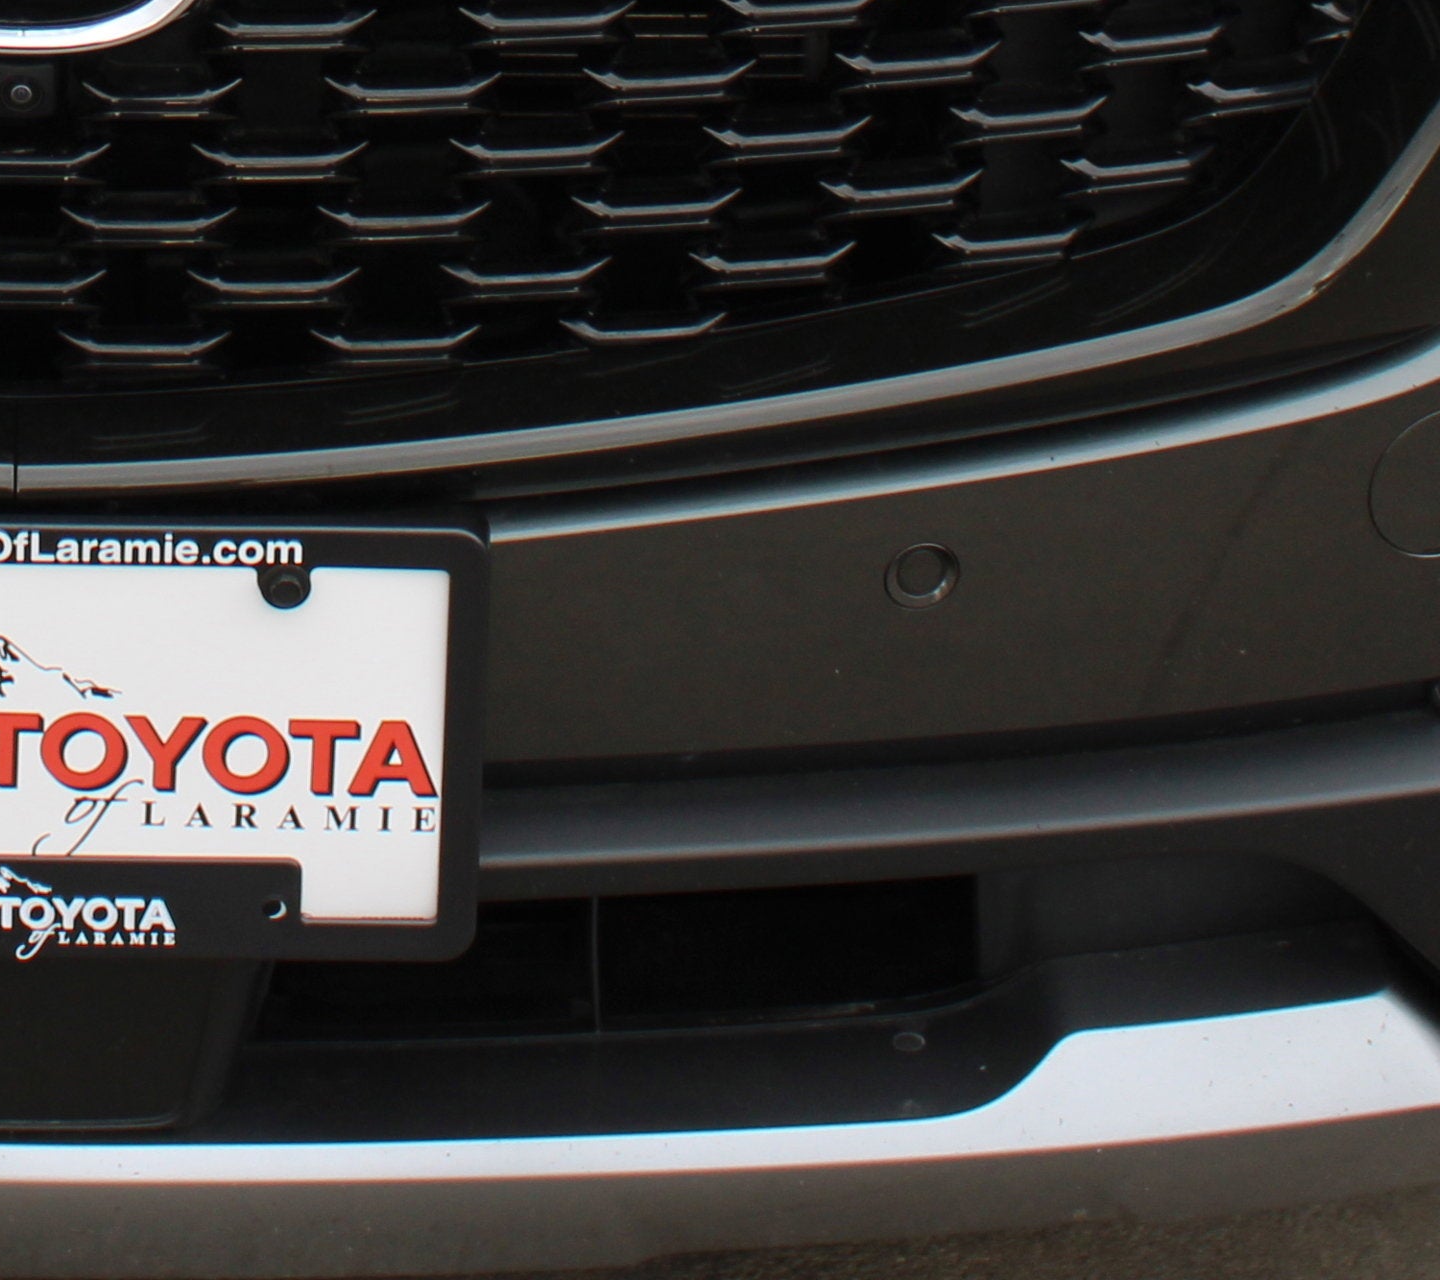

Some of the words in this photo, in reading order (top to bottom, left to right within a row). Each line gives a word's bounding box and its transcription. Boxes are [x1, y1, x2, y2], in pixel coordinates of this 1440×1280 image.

[32, 780, 144, 855] of
[141, 801, 436, 832] LARAMIE
[15, 923, 61, 961] of
[58, 931, 176, 946] LARAMIE
